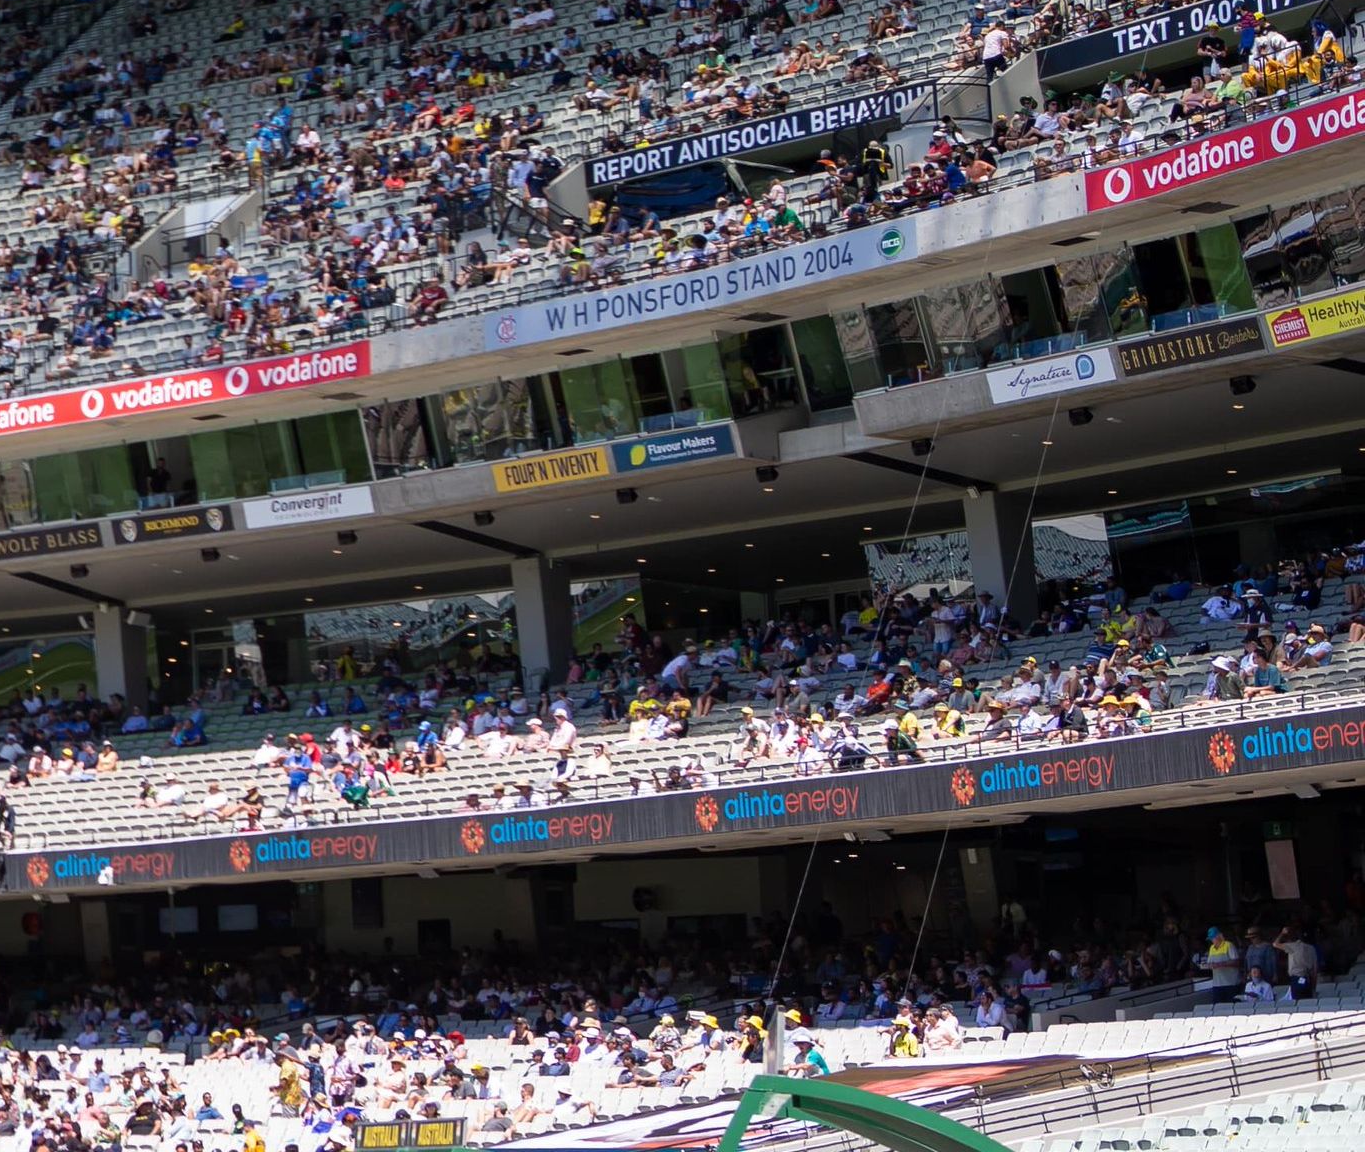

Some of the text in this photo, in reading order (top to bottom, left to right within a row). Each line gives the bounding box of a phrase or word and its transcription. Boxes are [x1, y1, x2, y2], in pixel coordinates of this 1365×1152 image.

[1112, 16, 1170, 53] TEXT
[1307, 94, 1365, 137] voda
[593, 86, 926, 185] REPORT ANTISOCIAL BEHAVIOU
[1142, 136, 1254, 189] vodafone
[546, 307, 567, 332] W
[574, 302, 588, 327] H
[596, 276, 720, 323] PONSFORD
[727, 256, 796, 294] STAND
[804, 241, 854, 277] 2004
[1308, 299, 1360, 322] Healthy
[1273, 318, 1306, 335] CHEMIST
[1120, 334, 1215, 370] GRINDSTONE
[258, 351, 358, 387] vodafone
[1007, 368, 1073, 396] Signature
[111, 376, 213, 409] vodafone
[647, 435, 715, 455] Flavour Makers
[505, 452, 601, 486] FOUR'N TWENTY
[271, 492, 342, 513] Convergint
[144, 515, 200, 532] RICHMOND
[46, 529, 99, 549] BLASS
[363, 1125, 399, 1147] AUSTRALIA
[417, 1122, 454, 1146] AUSTRALIA
